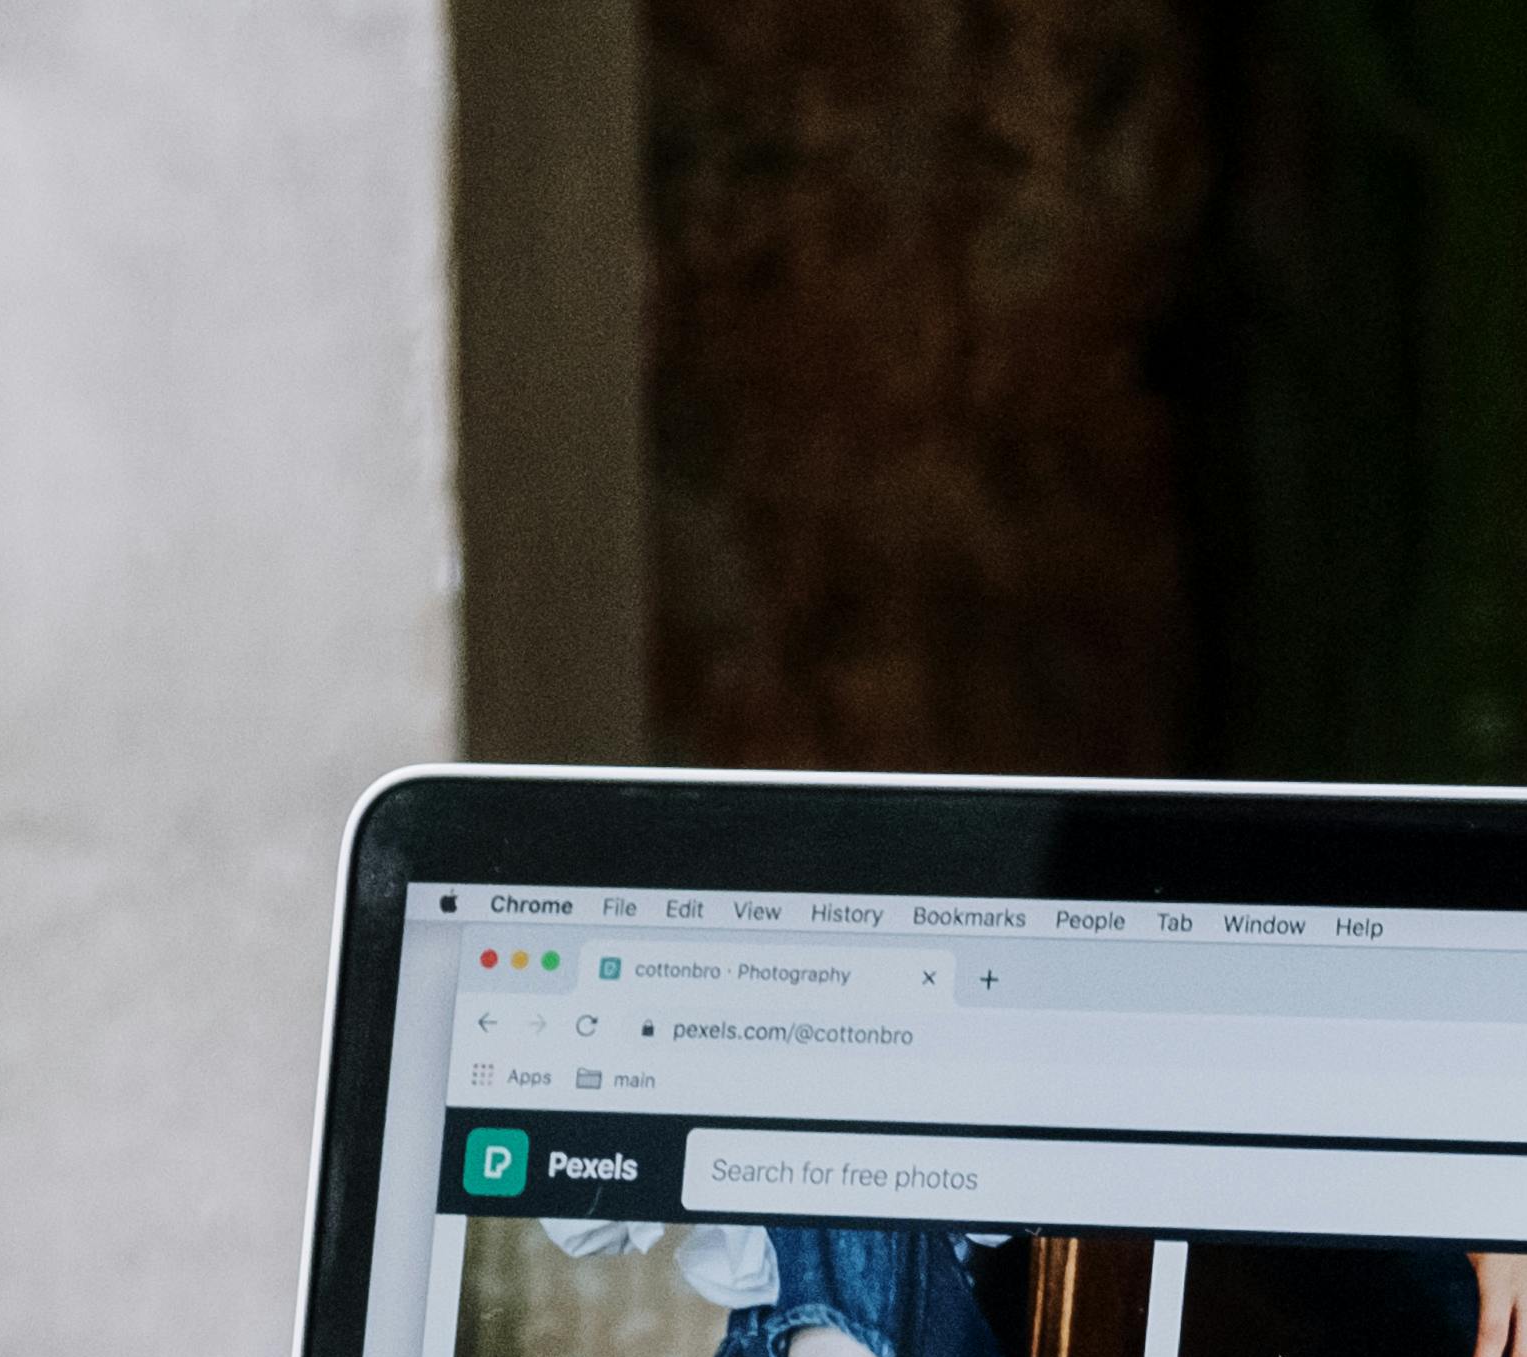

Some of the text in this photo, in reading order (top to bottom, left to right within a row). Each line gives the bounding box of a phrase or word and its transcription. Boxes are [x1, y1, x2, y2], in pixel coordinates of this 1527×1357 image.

[490, 894, 574, 915] Chrome
[602, 897, 638, 917] File
[665, 899, 704, 919] Edit
[733, 900, 782, 921] View
[811, 903, 884, 928] History
[912, 906, 1027, 928] Bookmarks
[1055, 910, 1126, 934] People
[1157, 912, 1194, 933] Tab
[1223, 915, 1306, 935] Window
[1335, 917, 1384, 940] Help
[634, 961, 852, 987] cottonbro Photography
[672, 1021, 914, 1046] pexels.com/@cottonbro
[507, 1068, 552, 1088] Apps
[613, 1072, 656, 1089] main
[548, 1150, 638, 1181] Pexels
[711, 1157, 979, 1192] Search for free photos
